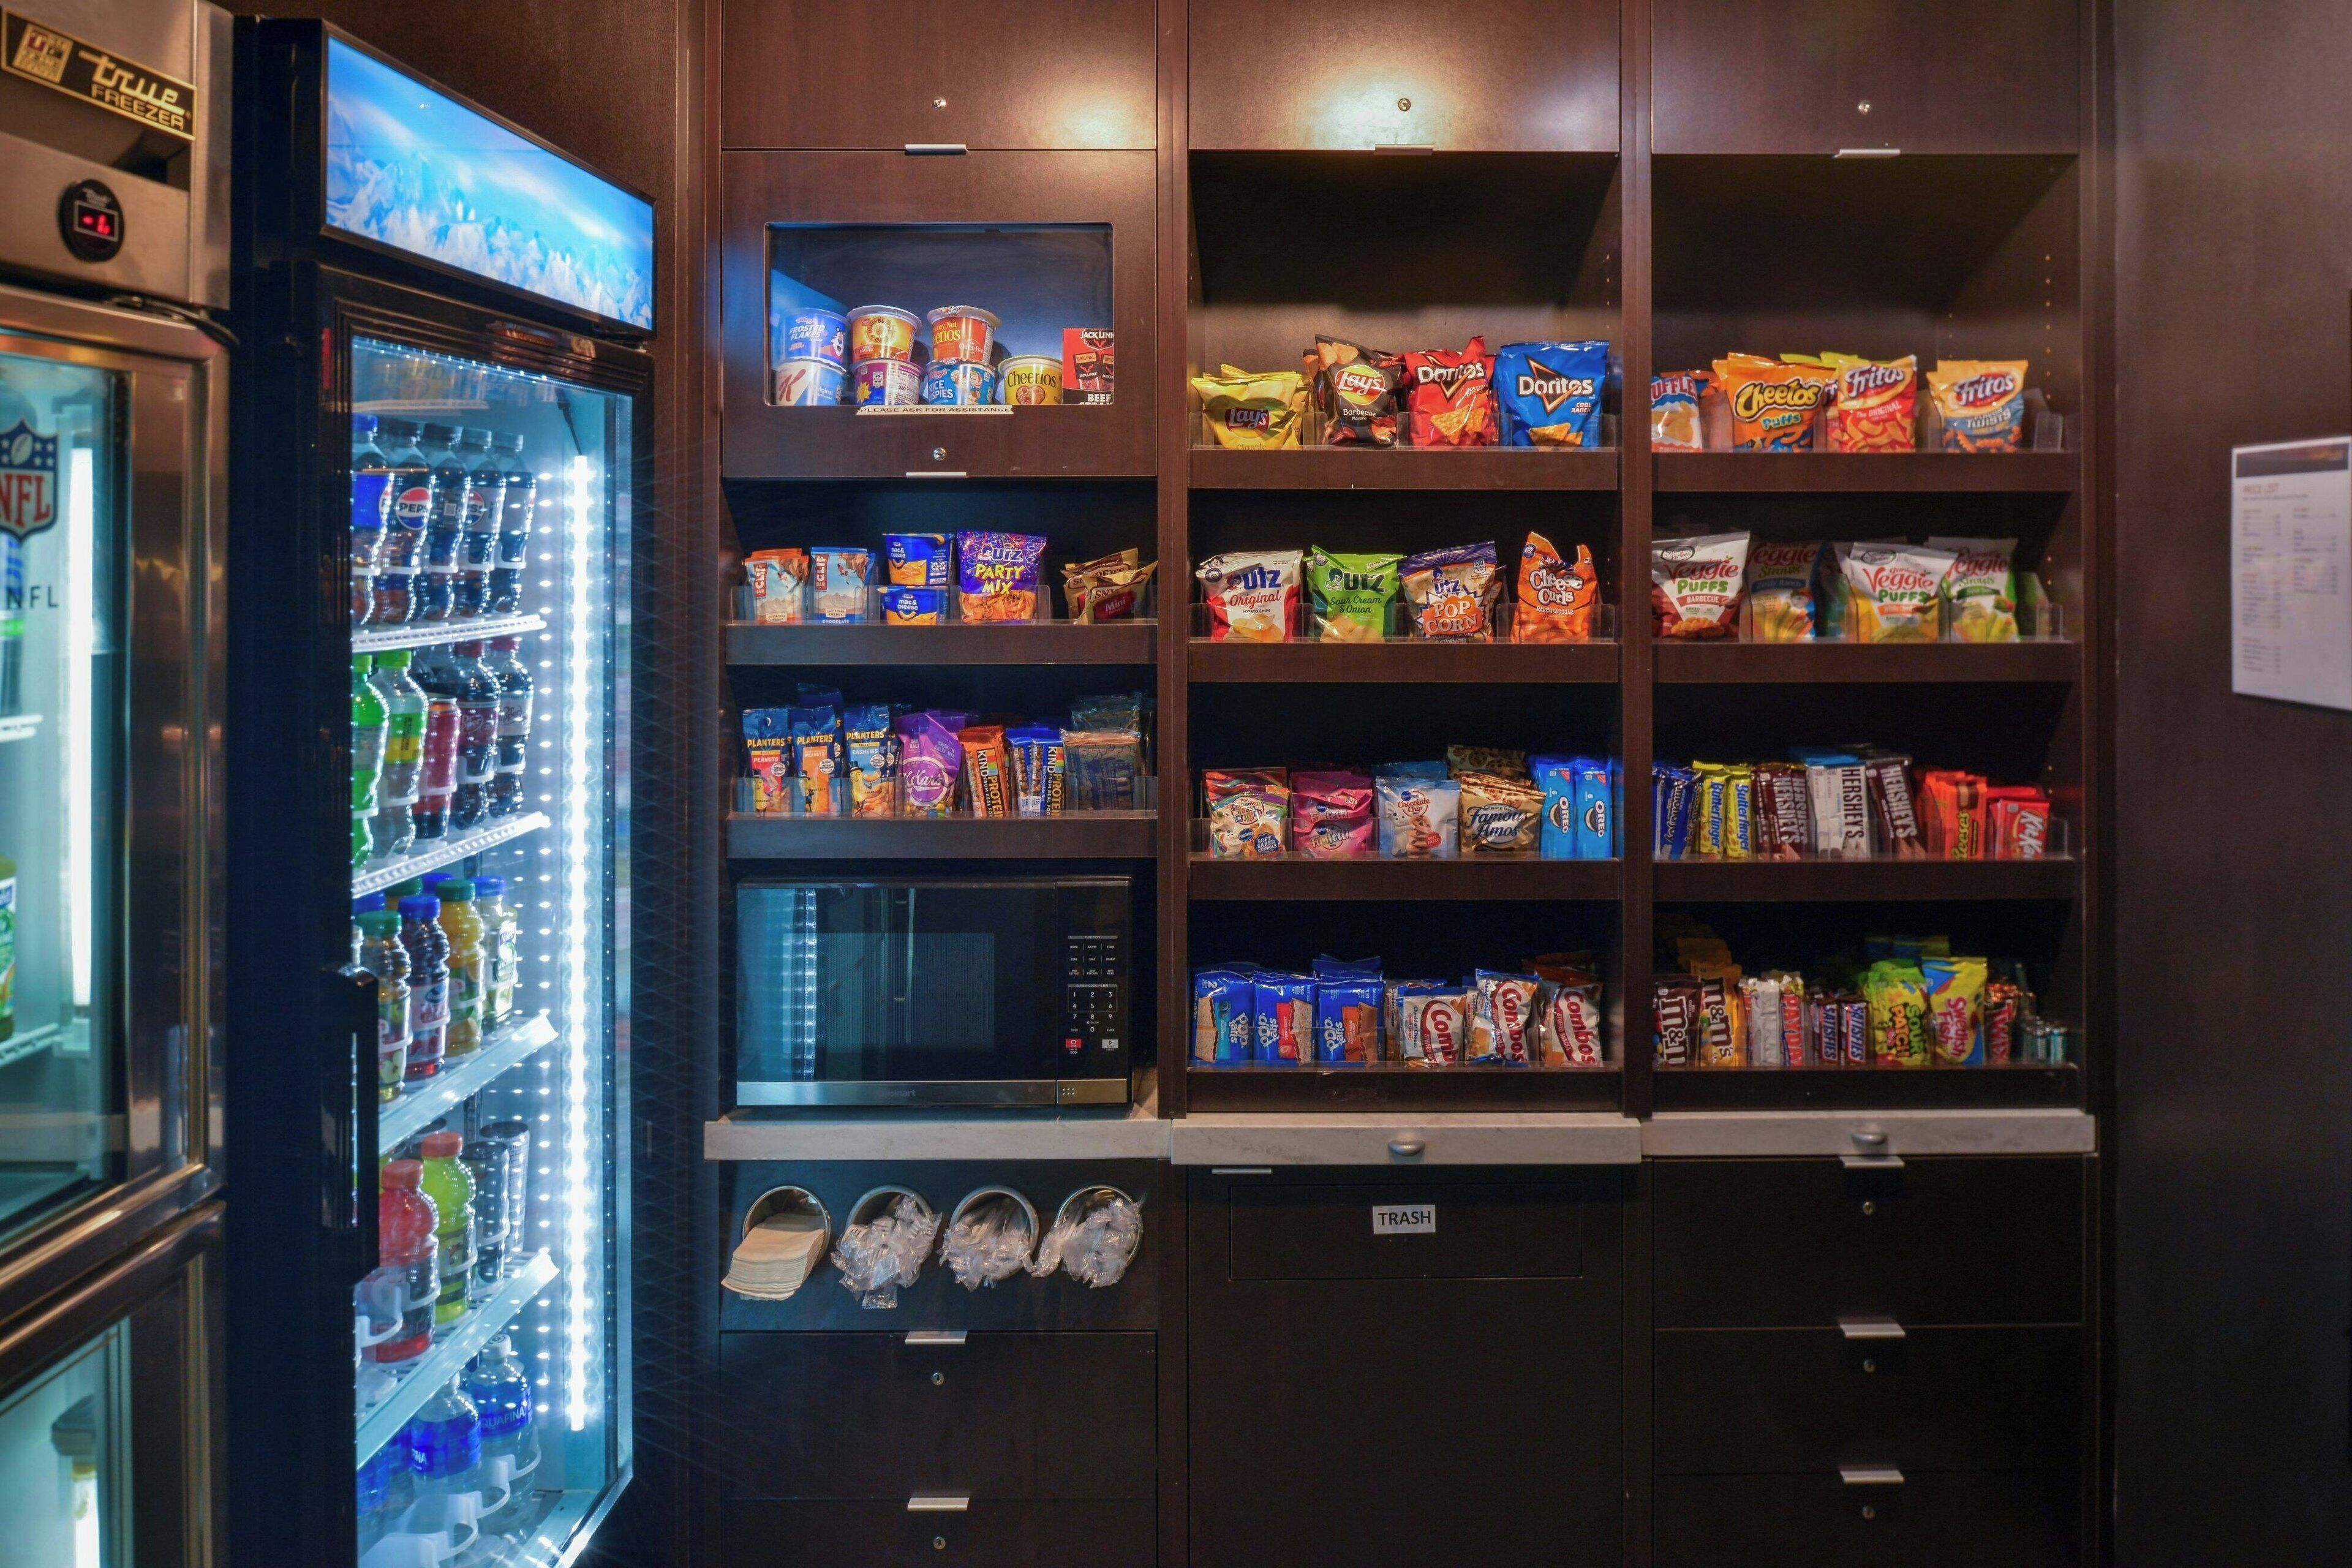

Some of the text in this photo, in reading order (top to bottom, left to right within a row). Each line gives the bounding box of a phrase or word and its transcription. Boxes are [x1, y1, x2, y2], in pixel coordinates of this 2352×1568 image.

[91, 83, 184, 130] FREEZER
[790, 324, 826, 334] FROSTED
[791, 331, 821, 341] FLAKES
[1008, 369, 1057, 388] Cheerios
[1417, 362, 1485, 383] Doritos
[1845, 364, 1904, 398] Fritos
[929, 380, 945, 390] RICE
[1519, 376, 1593, 395] Doritos
[1954, 374, 2015, 406] Fritos
[1087, 393, 1112, 402] BEEF
[1736, 378, 1822, 418] Cheetos
[1229, 409, 1269, 429] Lay's
[1343, 408, 1377, 417] Barbecue
[1868, 401, 1902, 417] ORIGINAL
[1762, 412, 1801, 430] Puffs
[755, 564, 767, 589] CLIF
[816, 556, 826, 581] CLIF
[974, 564, 1025, 579] PARTY
[1663, 562, 1739, 584] Veggie
[981, 579, 1014, 596] MIX
[1529, 568, 1584, 592] Cheese
[1677, 579, 1728, 594] PUFFS
[1862, 567, 1934, 593] Veggie
[7, 586, 59, 609] NFL
[1105, 597, 1127, 612] Mini
[1229, 589, 1282, 609] Original
[1330, 595, 1382, 606] Sour Cream
[1537, 588, 1575, 606] Curls
[1878, 589, 1928, 603] PUFFS
[1339, 605, 1373, 613] & Onion
[1434, 600, 1471, 619] POP
[1425, 613, 1479, 634] CORN
[747, 738, 785, 748] PLANTERS
[797, 734, 835, 745] PLANTERS
[846, 731, 885, 740] PLANTERS
[977, 750, 990, 777] KIND
[1047, 746, 1058, 774] KIND
[1398, 797, 1431, 809] Chocolate
[1773, 777, 1801, 844] HERSHEY'S
[1842, 768, 1864, 839] HERSHEY'S
[1880, 764, 1918, 839] HERSHEY'S
[1235, 809, 1264, 824] Crunch
[1468, 806, 1528, 826] Famous
[1559, 796, 1569, 834] OREO
[1595, 800, 1605, 837] OREO
[1708, 781, 1725, 849] Butterfinger
[1735, 783, 1750, 851] Butterfinger
[1257, 835, 1272, 844] SOFT
[1311, 829, 1350, 849] Funfetti
[1471, 823, 1520, 840] Amos
[1257, 839, 1276, 849] BAKED
[1258, 844, 1278, 853] COOKIES
[1228, 1019, 1238, 1044] tarts
[1270, 1017, 1280, 1044] tarts
[1335, 1021, 1346, 1046] tarts
[1502, 987, 1525, 1063] Combos
[1556, 1012, 1572, 1052] STUFFED SNACKS
[1564, 990, 1596, 1065] Combos
[1823, 1007, 1837, 1060] SATISFIES
[1850, 1005, 1866, 1061] SATISFIES
[1890, 1004, 1911, 1057] PATCH
[1905, 1004, 1924, 1054] SOUR
[1937, 1011, 1953, 1045] Fish
[1946, 995, 1969, 1058] Swedish
[1431, 1009, 1460, 1067] Comb
[1378, 1210, 1431, 1226] TRASH
[481, 1406, 526, 1430] QUAFINA
